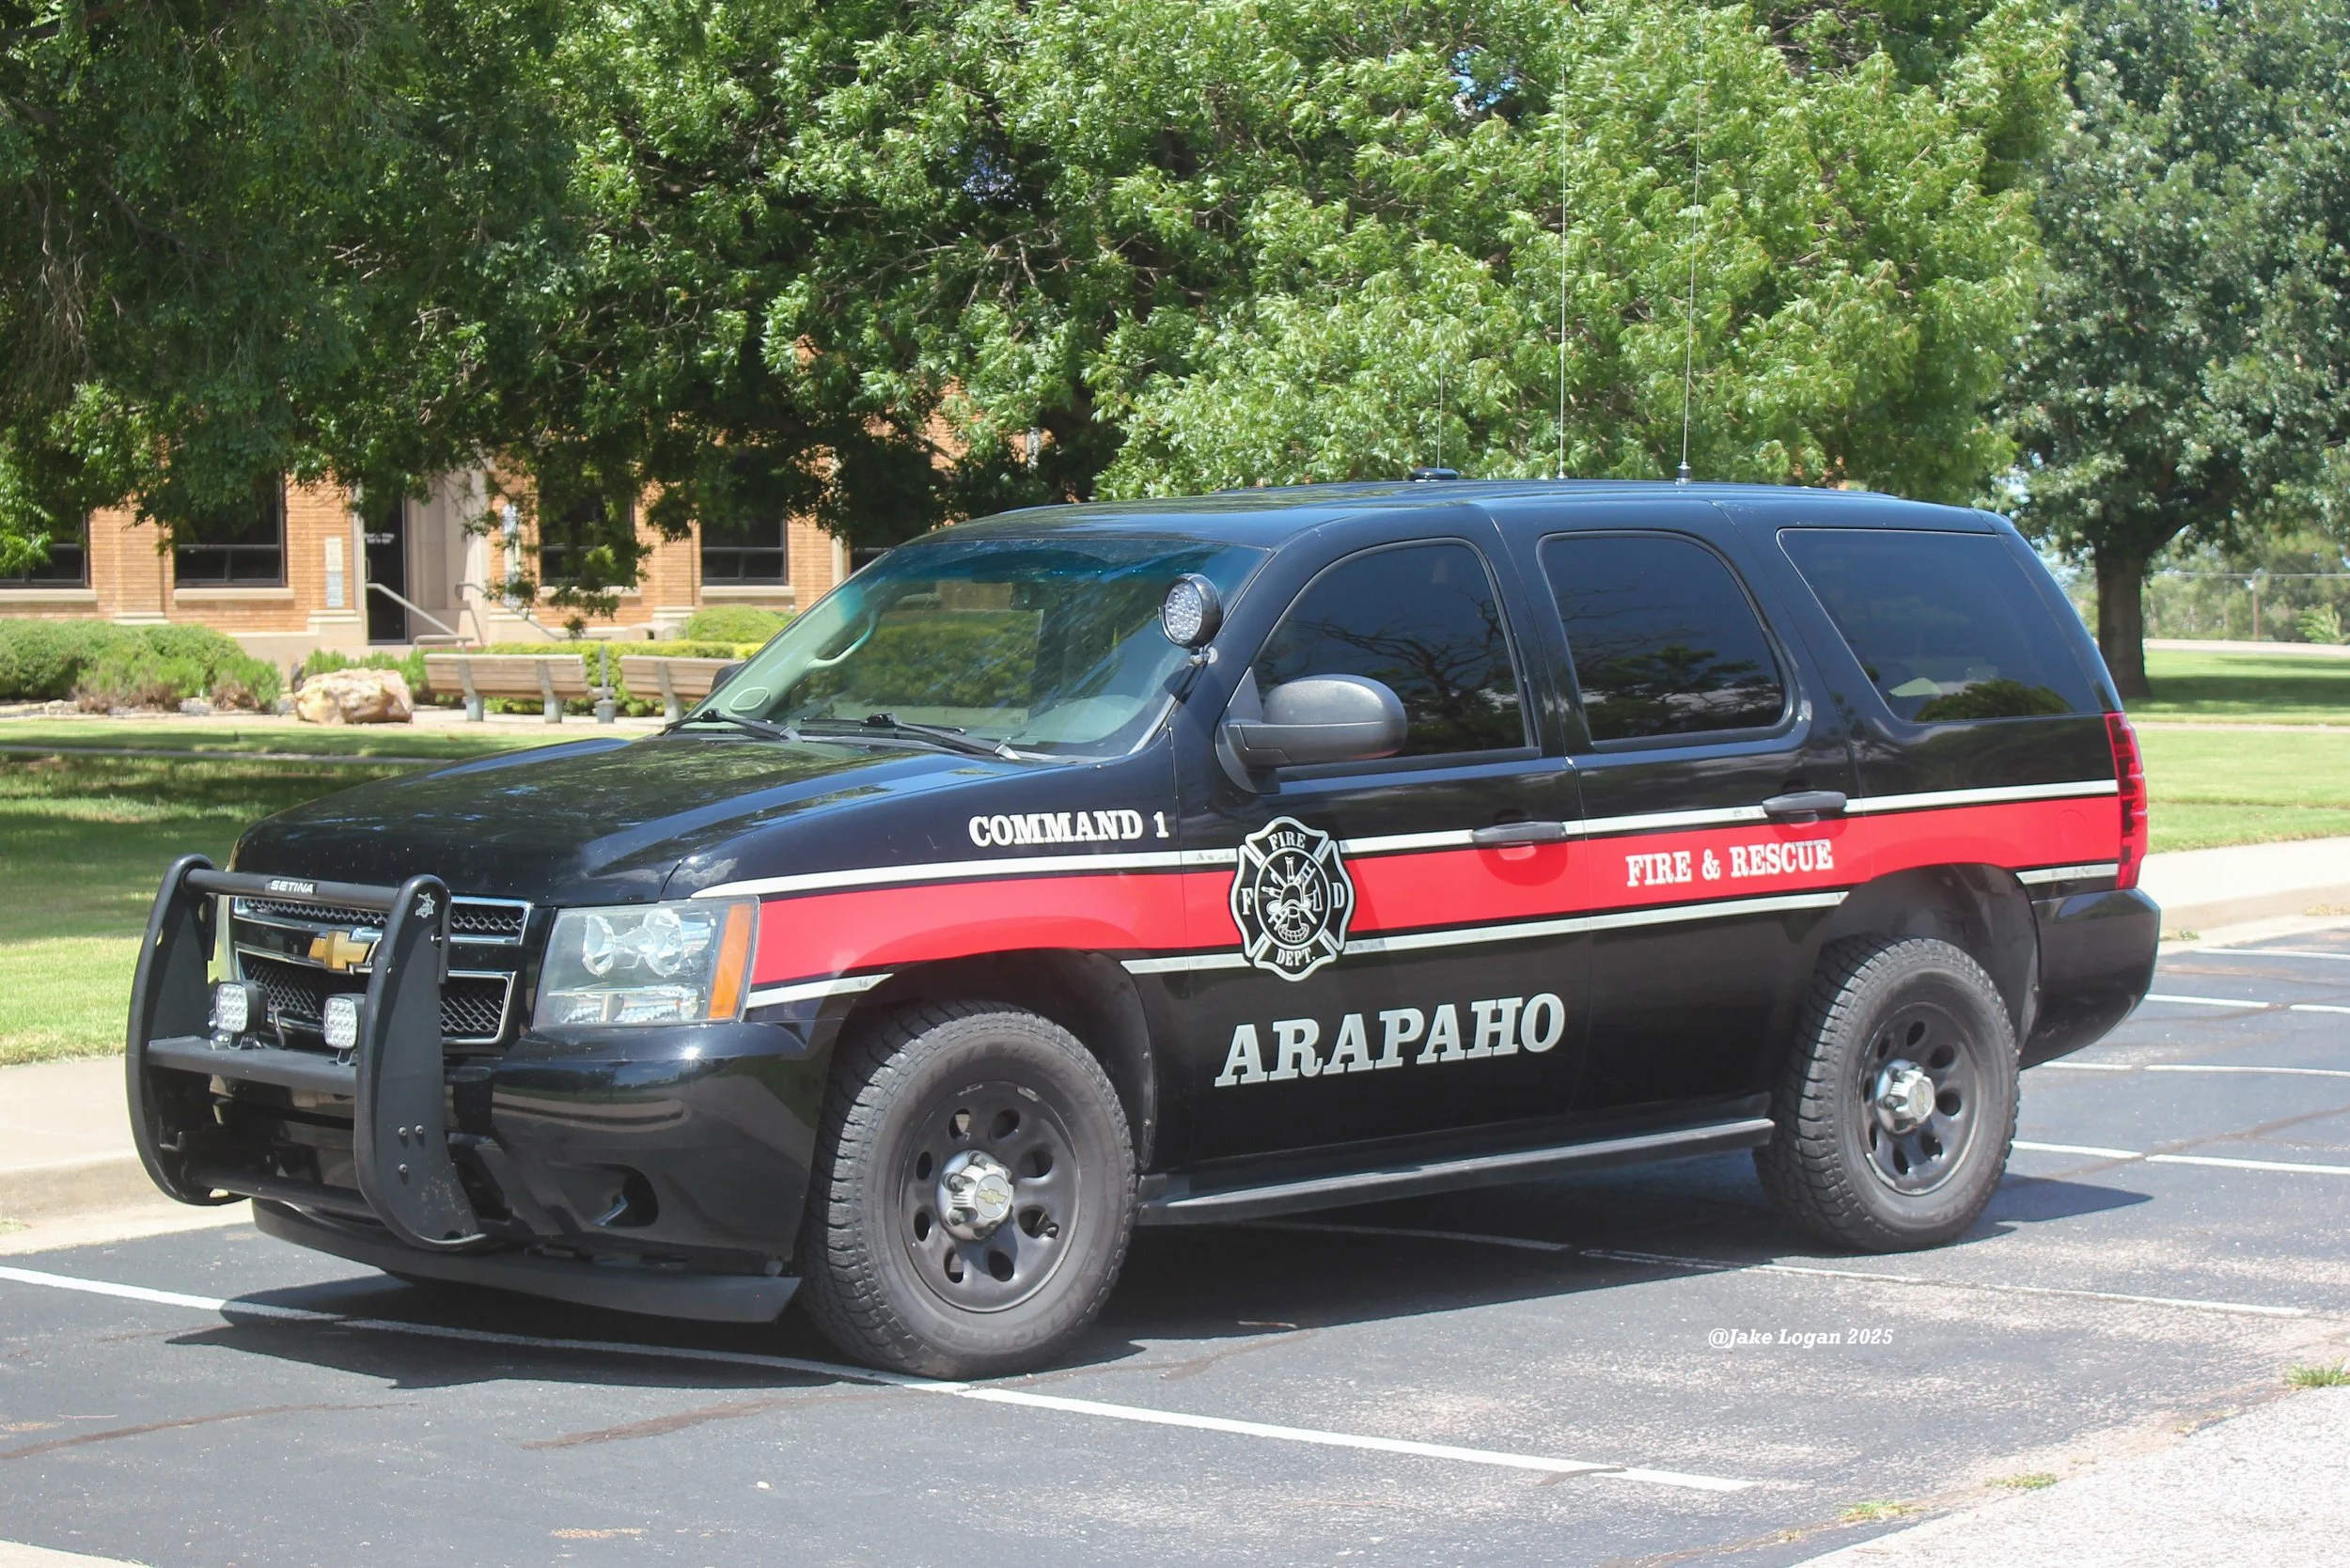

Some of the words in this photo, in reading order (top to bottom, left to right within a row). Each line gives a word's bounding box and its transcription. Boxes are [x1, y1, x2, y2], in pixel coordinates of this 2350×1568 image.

[968, 809, 1144, 847] COMMAND
[1152, 811, 1169, 838] 1
[1269, 831, 1307, 852] FIRE
[1625, 850, 1692, 887] FIRE
[1701, 848, 1721, 881] &
[1729, 839, 1834, 878] RESCUE
[270, 880, 314, 894] SETINA
[1241, 887, 1253, 915] F
[1332, 882, 1345, 908] D
[1275, 949, 1316, 966] DEPT.
[1214, 993, 1565, 1088] ARAPAHO
